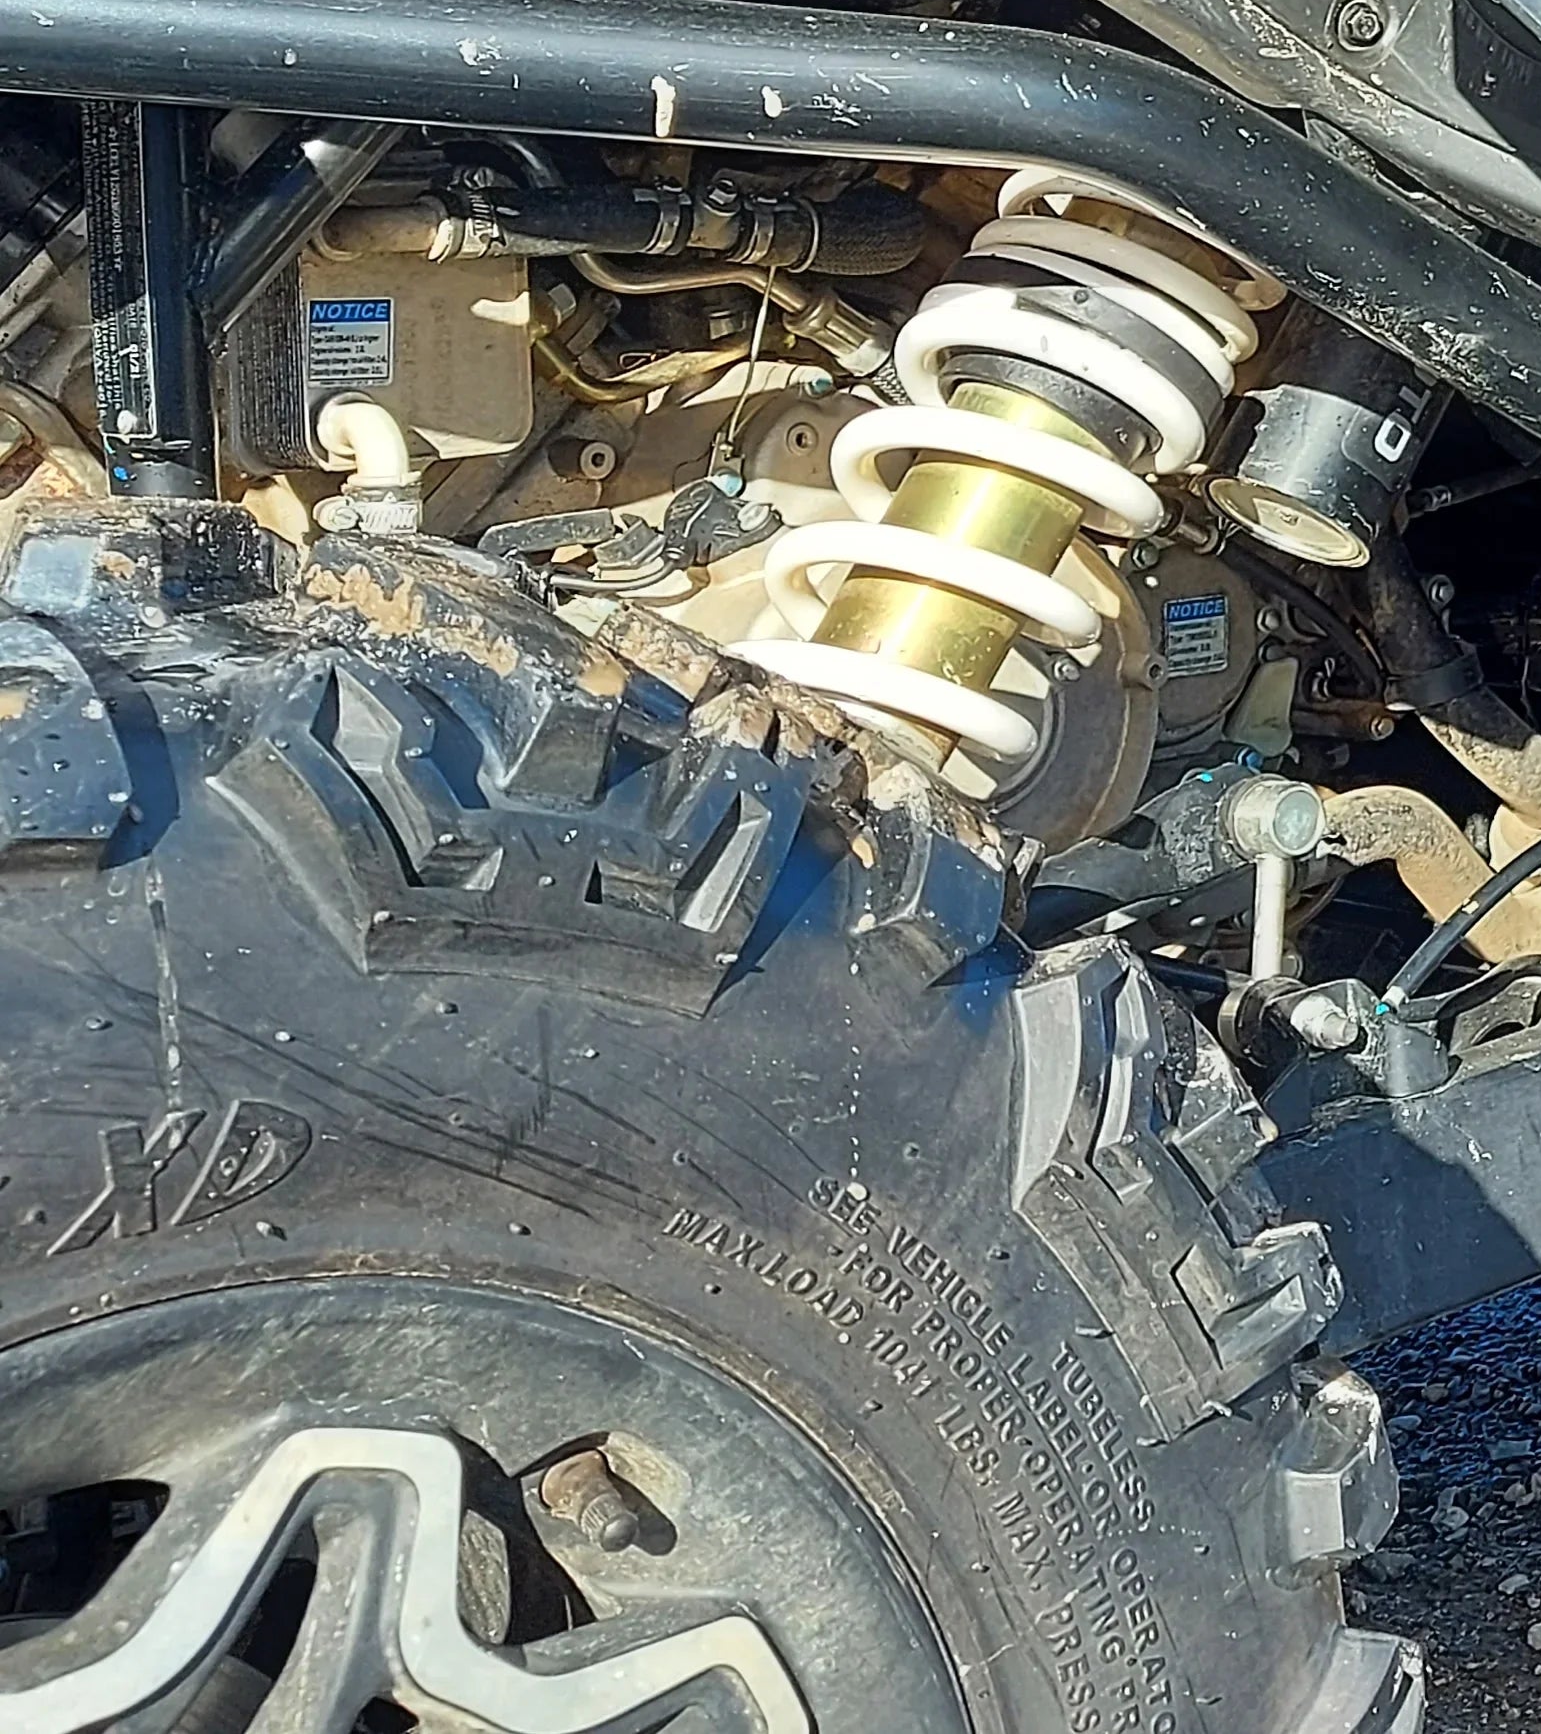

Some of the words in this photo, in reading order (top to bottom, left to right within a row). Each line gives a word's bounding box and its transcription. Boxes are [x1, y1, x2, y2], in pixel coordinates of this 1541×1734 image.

[312, 302, 389, 321] NOTICE
[1168, 599, 1225, 620] NOTICE
[808, 1176, 882, 1237] SEE
[887, 1223, 1015, 1358] VEHICLE
[1006, 1352, 1088, 1472] LABEL
[1082, 1476, 1121, 1540] OR
[863, 1326, 942, 1398] 1041
[836, 1243, 914, 1314] FOR
[910, 1308, 1028, 1444] PROPER
[1018, 1448, 1126, 1664] OPERATING
[1052, 1339, 1156, 1531] TUBELESS
